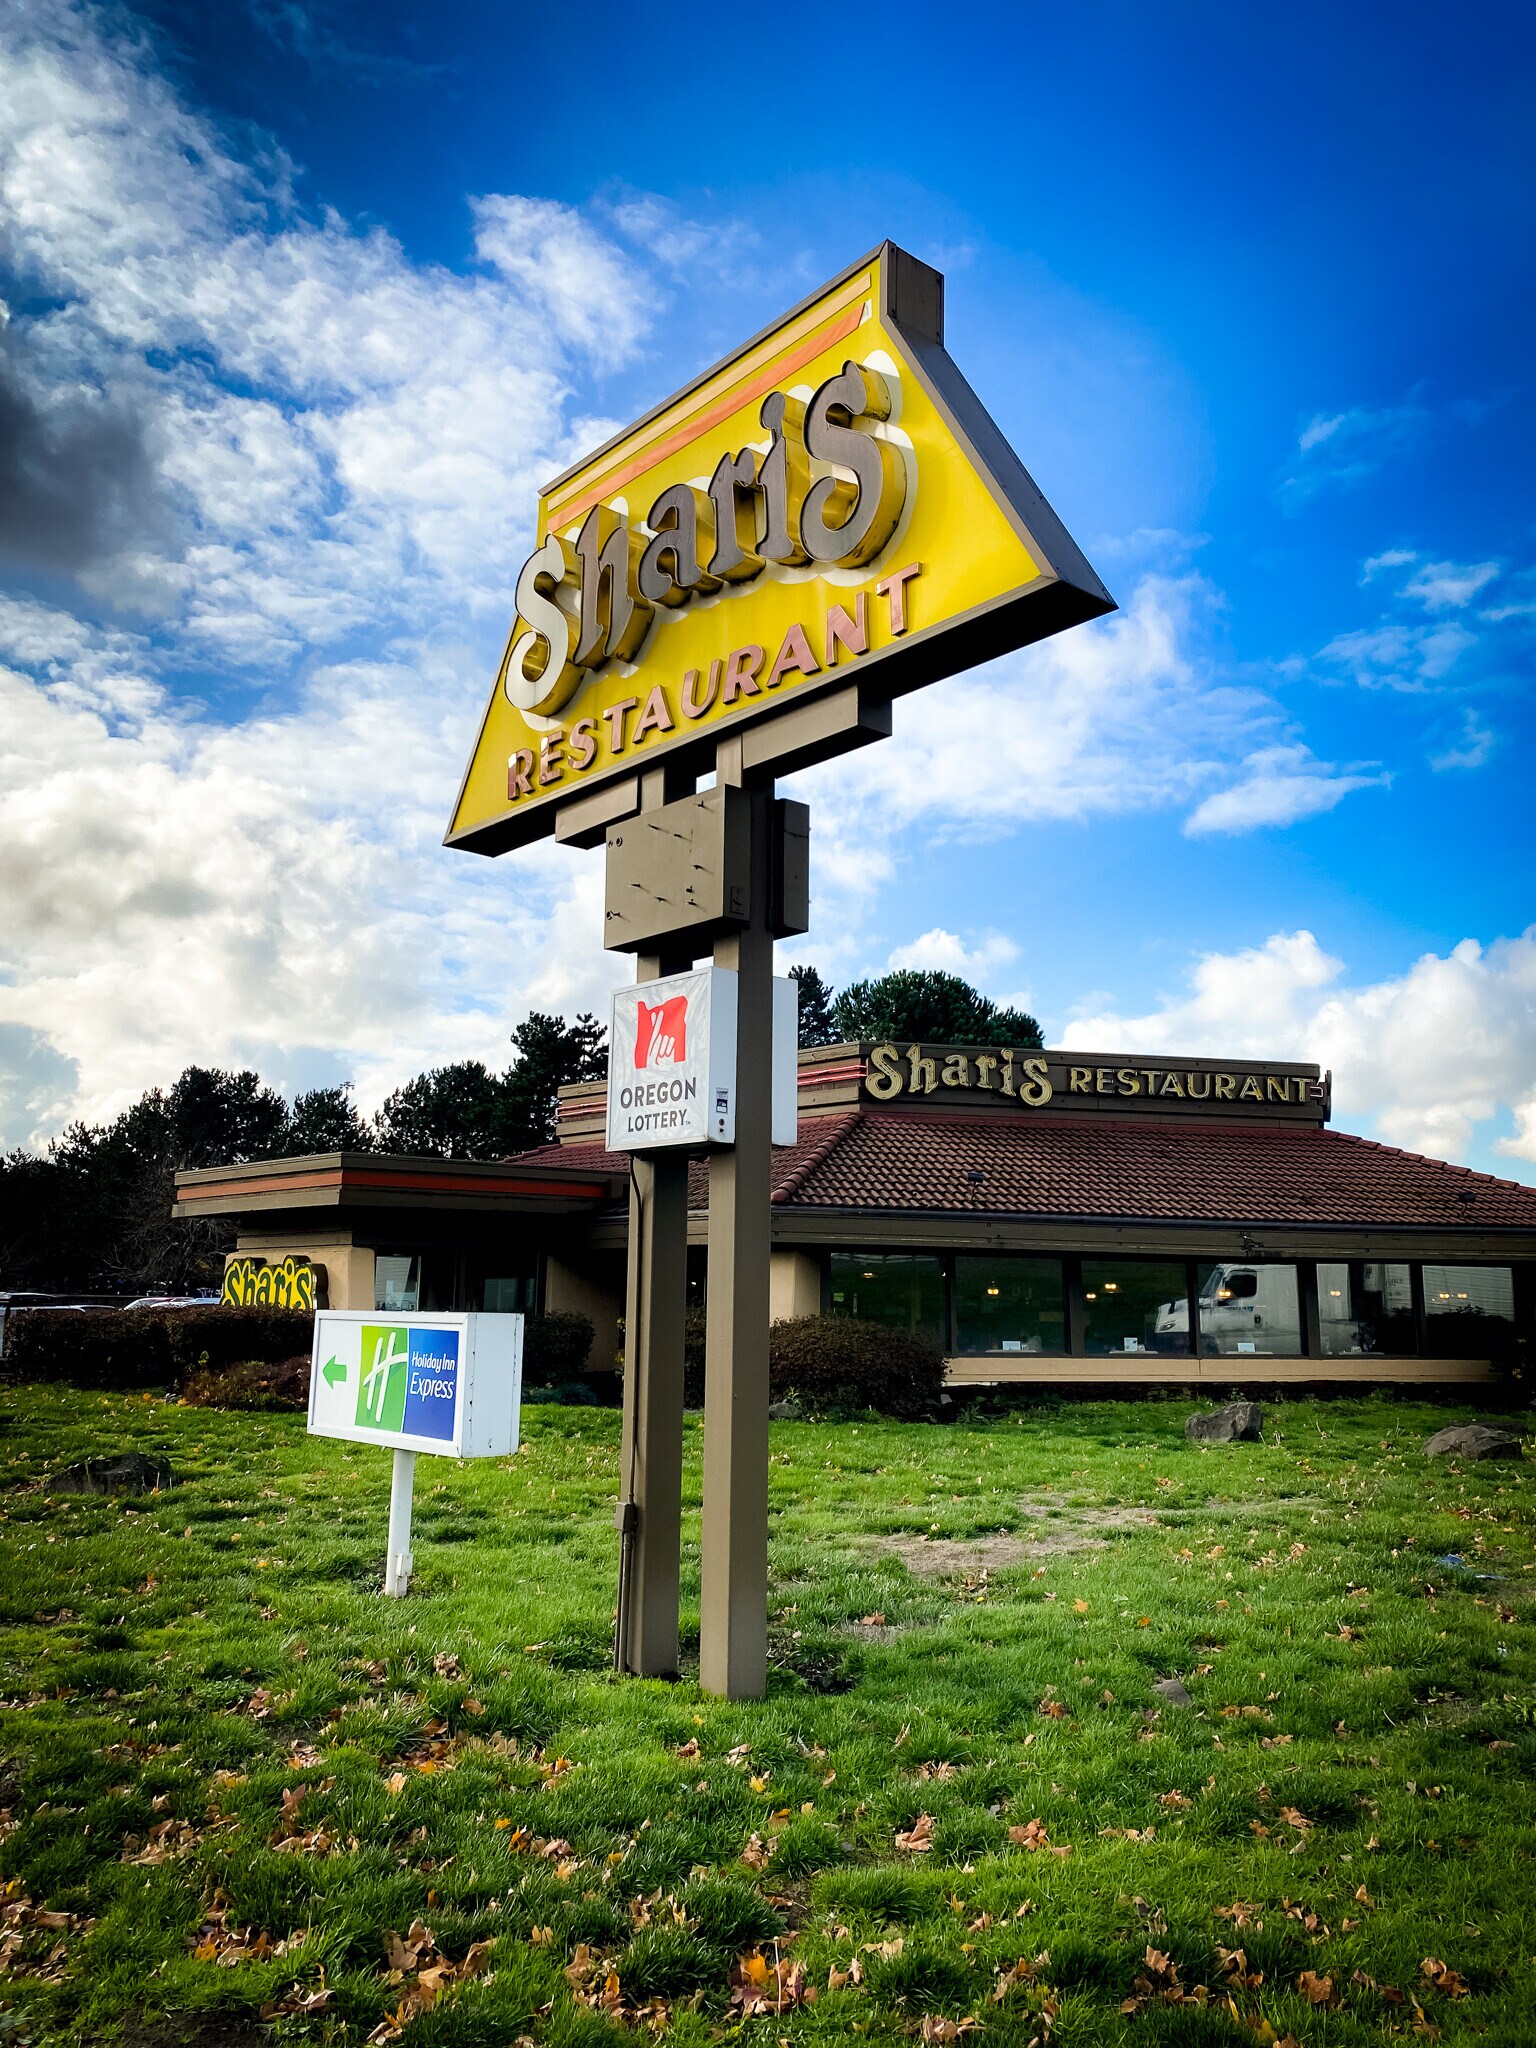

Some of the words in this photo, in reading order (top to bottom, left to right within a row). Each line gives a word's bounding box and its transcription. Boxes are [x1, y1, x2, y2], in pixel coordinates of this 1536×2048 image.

[507, 561, 924, 801] RESTAURANT
[620, 1076, 697, 1109] OREGON
[1070, 1067, 1312, 1102] RESTAURANT
[627, 1108, 688, 1133] LOTTERY
[409, 1371, 454, 1402] Express
